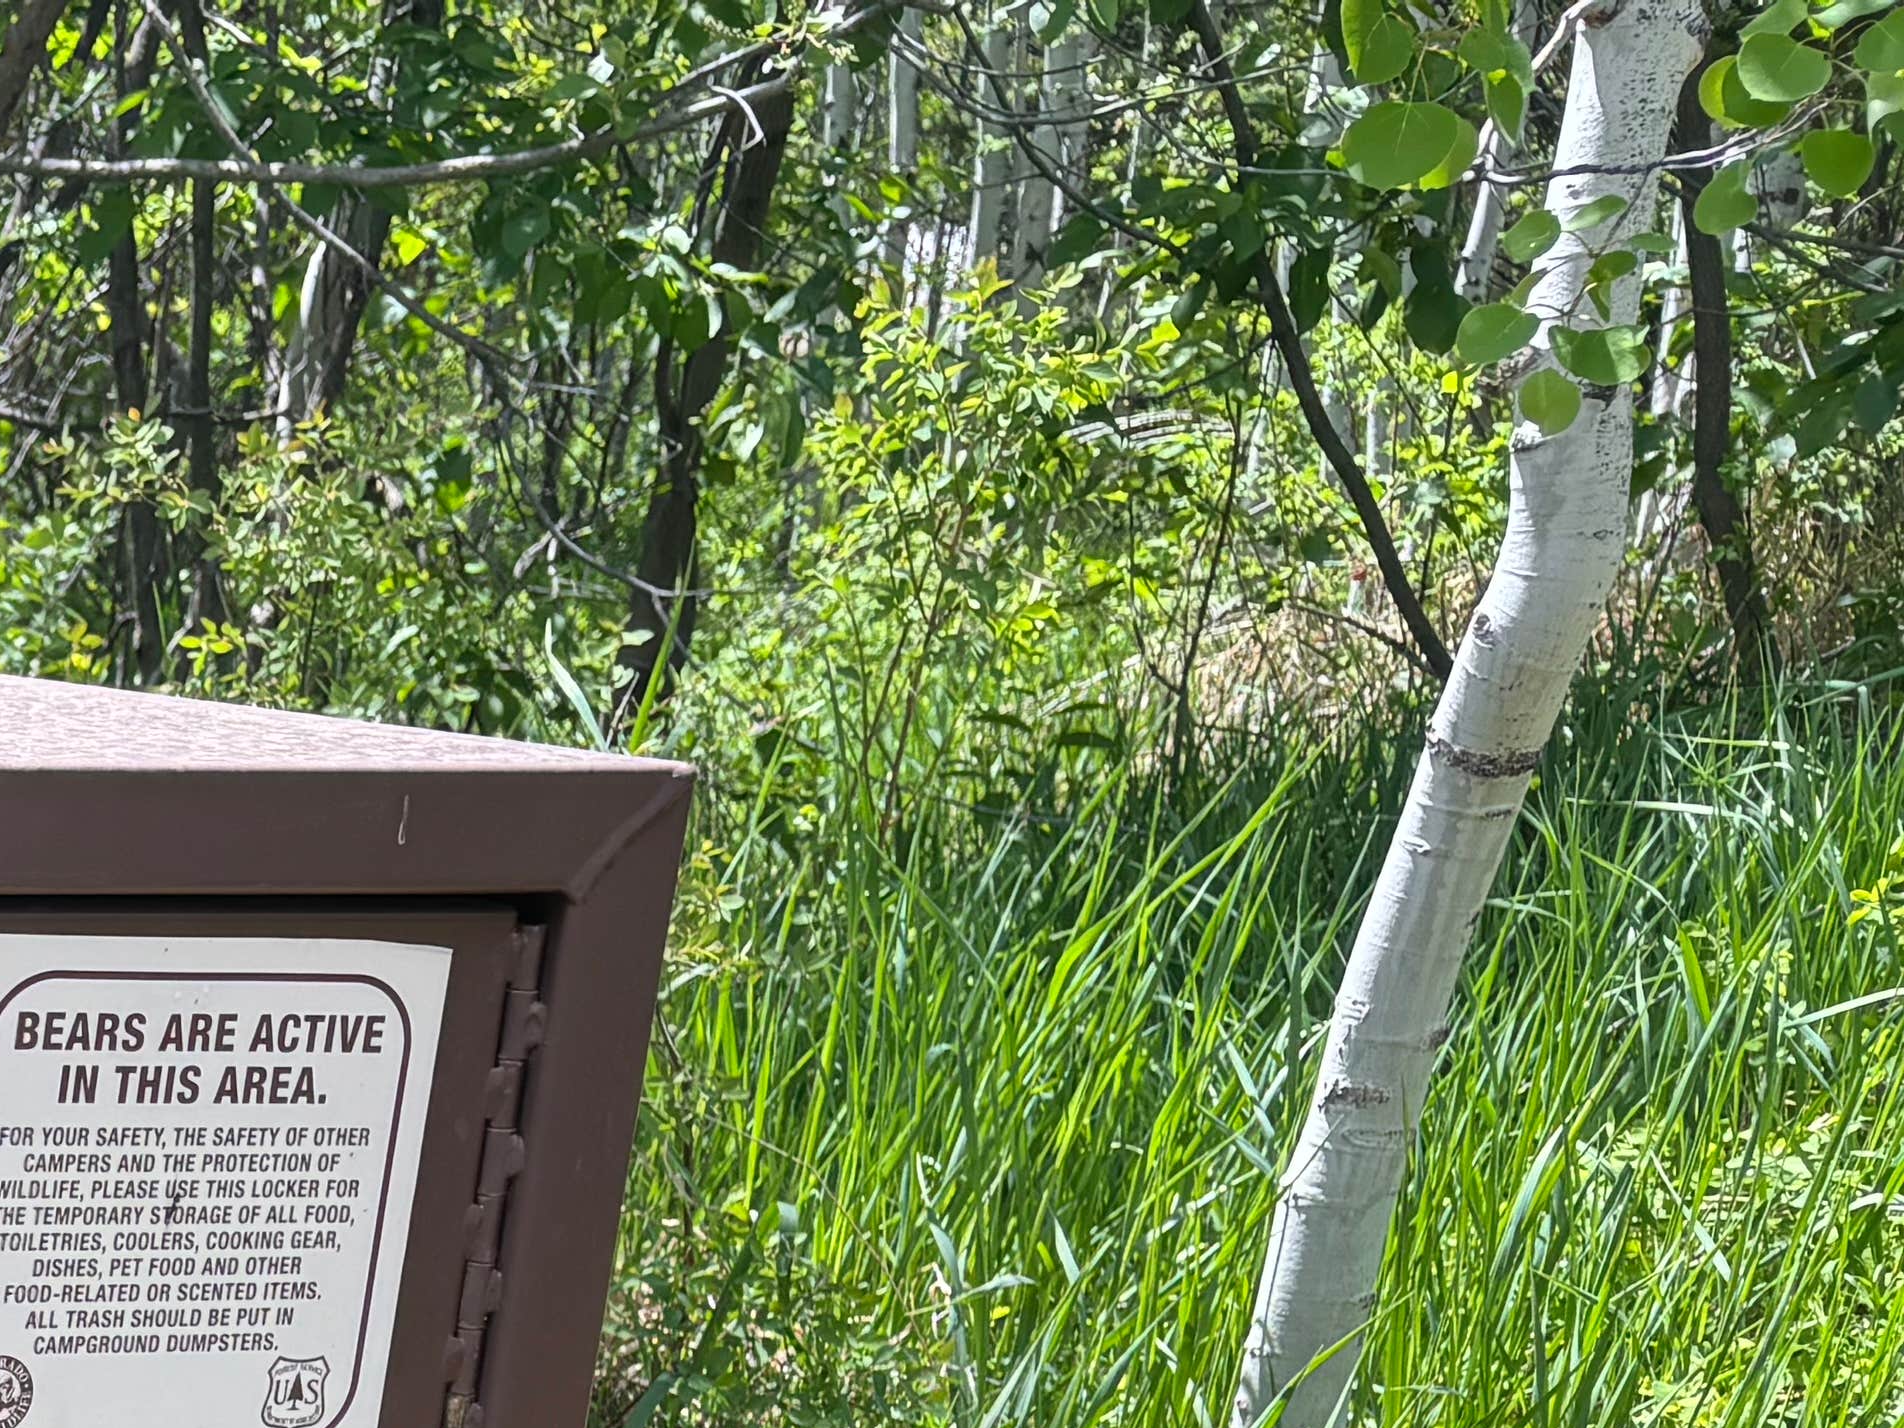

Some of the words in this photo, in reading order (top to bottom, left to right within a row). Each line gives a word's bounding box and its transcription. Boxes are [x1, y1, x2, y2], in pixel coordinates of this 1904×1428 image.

[13, 1010, 147, 1052] BEARS
[157, 1012, 238, 1052] ARE
[247, 1013, 386, 1053] ACTIVE
[57, 1064, 99, 1104] IN
[114, 1064, 201, 1104] THIS
[212, 1065, 326, 1104] AREA.
[41, 1126, 90, 1146] YOUR
[95, 1126, 166, 1150] SAFETY,
[173, 1126, 207, 1146] THE
[211, 1126, 280, 1146] SAFETY
[284, 1126, 309, 1146] OF
[312, 1126, 370, 1146] OTHER
[22, 1153, 111, 1173] CAMPERS
[116, 1153, 155, 1173] AND
[162, 1153, 196, 1173] THE
[200, 1152, 312, 1172] PROTECTION
[317, 1152, 341, 1172] OF
[90, 1179, 160, 1199] PLEASE
[164, 1179, 200, 1199] USE
[205, 1179, 245, 1198] THIS
[250, 1178, 320, 1198] LOCKER
[324, 1178, 360, 1198] FOR
[32, 1205, 144, 1225] TEMPORARY
[149, 1205, 233, 1225] STORAGE
[237, 1204, 261, 1224] OF
[264, 1204, 297, 1224] ALL
[303, 1204, 355, 1226] FOOD,
[112, 1231, 199, 1253] COOLERS,
[205, 1230, 284, 1250] COOKING
[290, 1229, 341, 1252] GEAR,
[31, 1257, 102, 1280] DISHES,
[108, 1257, 143, 1277] PET
[147, 1257, 196, 1277] FOOD
[200, 1256, 239, 1276] AND
[244, 1255, 302, 1275] OTHER
[3, 1283, 140, 1304] FOOD-RELATED
[146, 1282, 171, 1302] OR
[176, 1281, 257, 1301] SCENTED
[262, 1280, 321, 1301] ITEMS.
[24, 1309, 58, 1329] ALL
[65, 1309, 125, 1329] TRASH
[129, 1308, 202, 1328] SHOULD
[207, 1307, 231, 1327] BE
[235, 1306, 271, 1326] PUT
[274, 1306, 294, 1325] IN
[32, 1334, 160, 1355] CAMPGROUND
[165, 1331, 278, 1352] DUMPSTERS.
